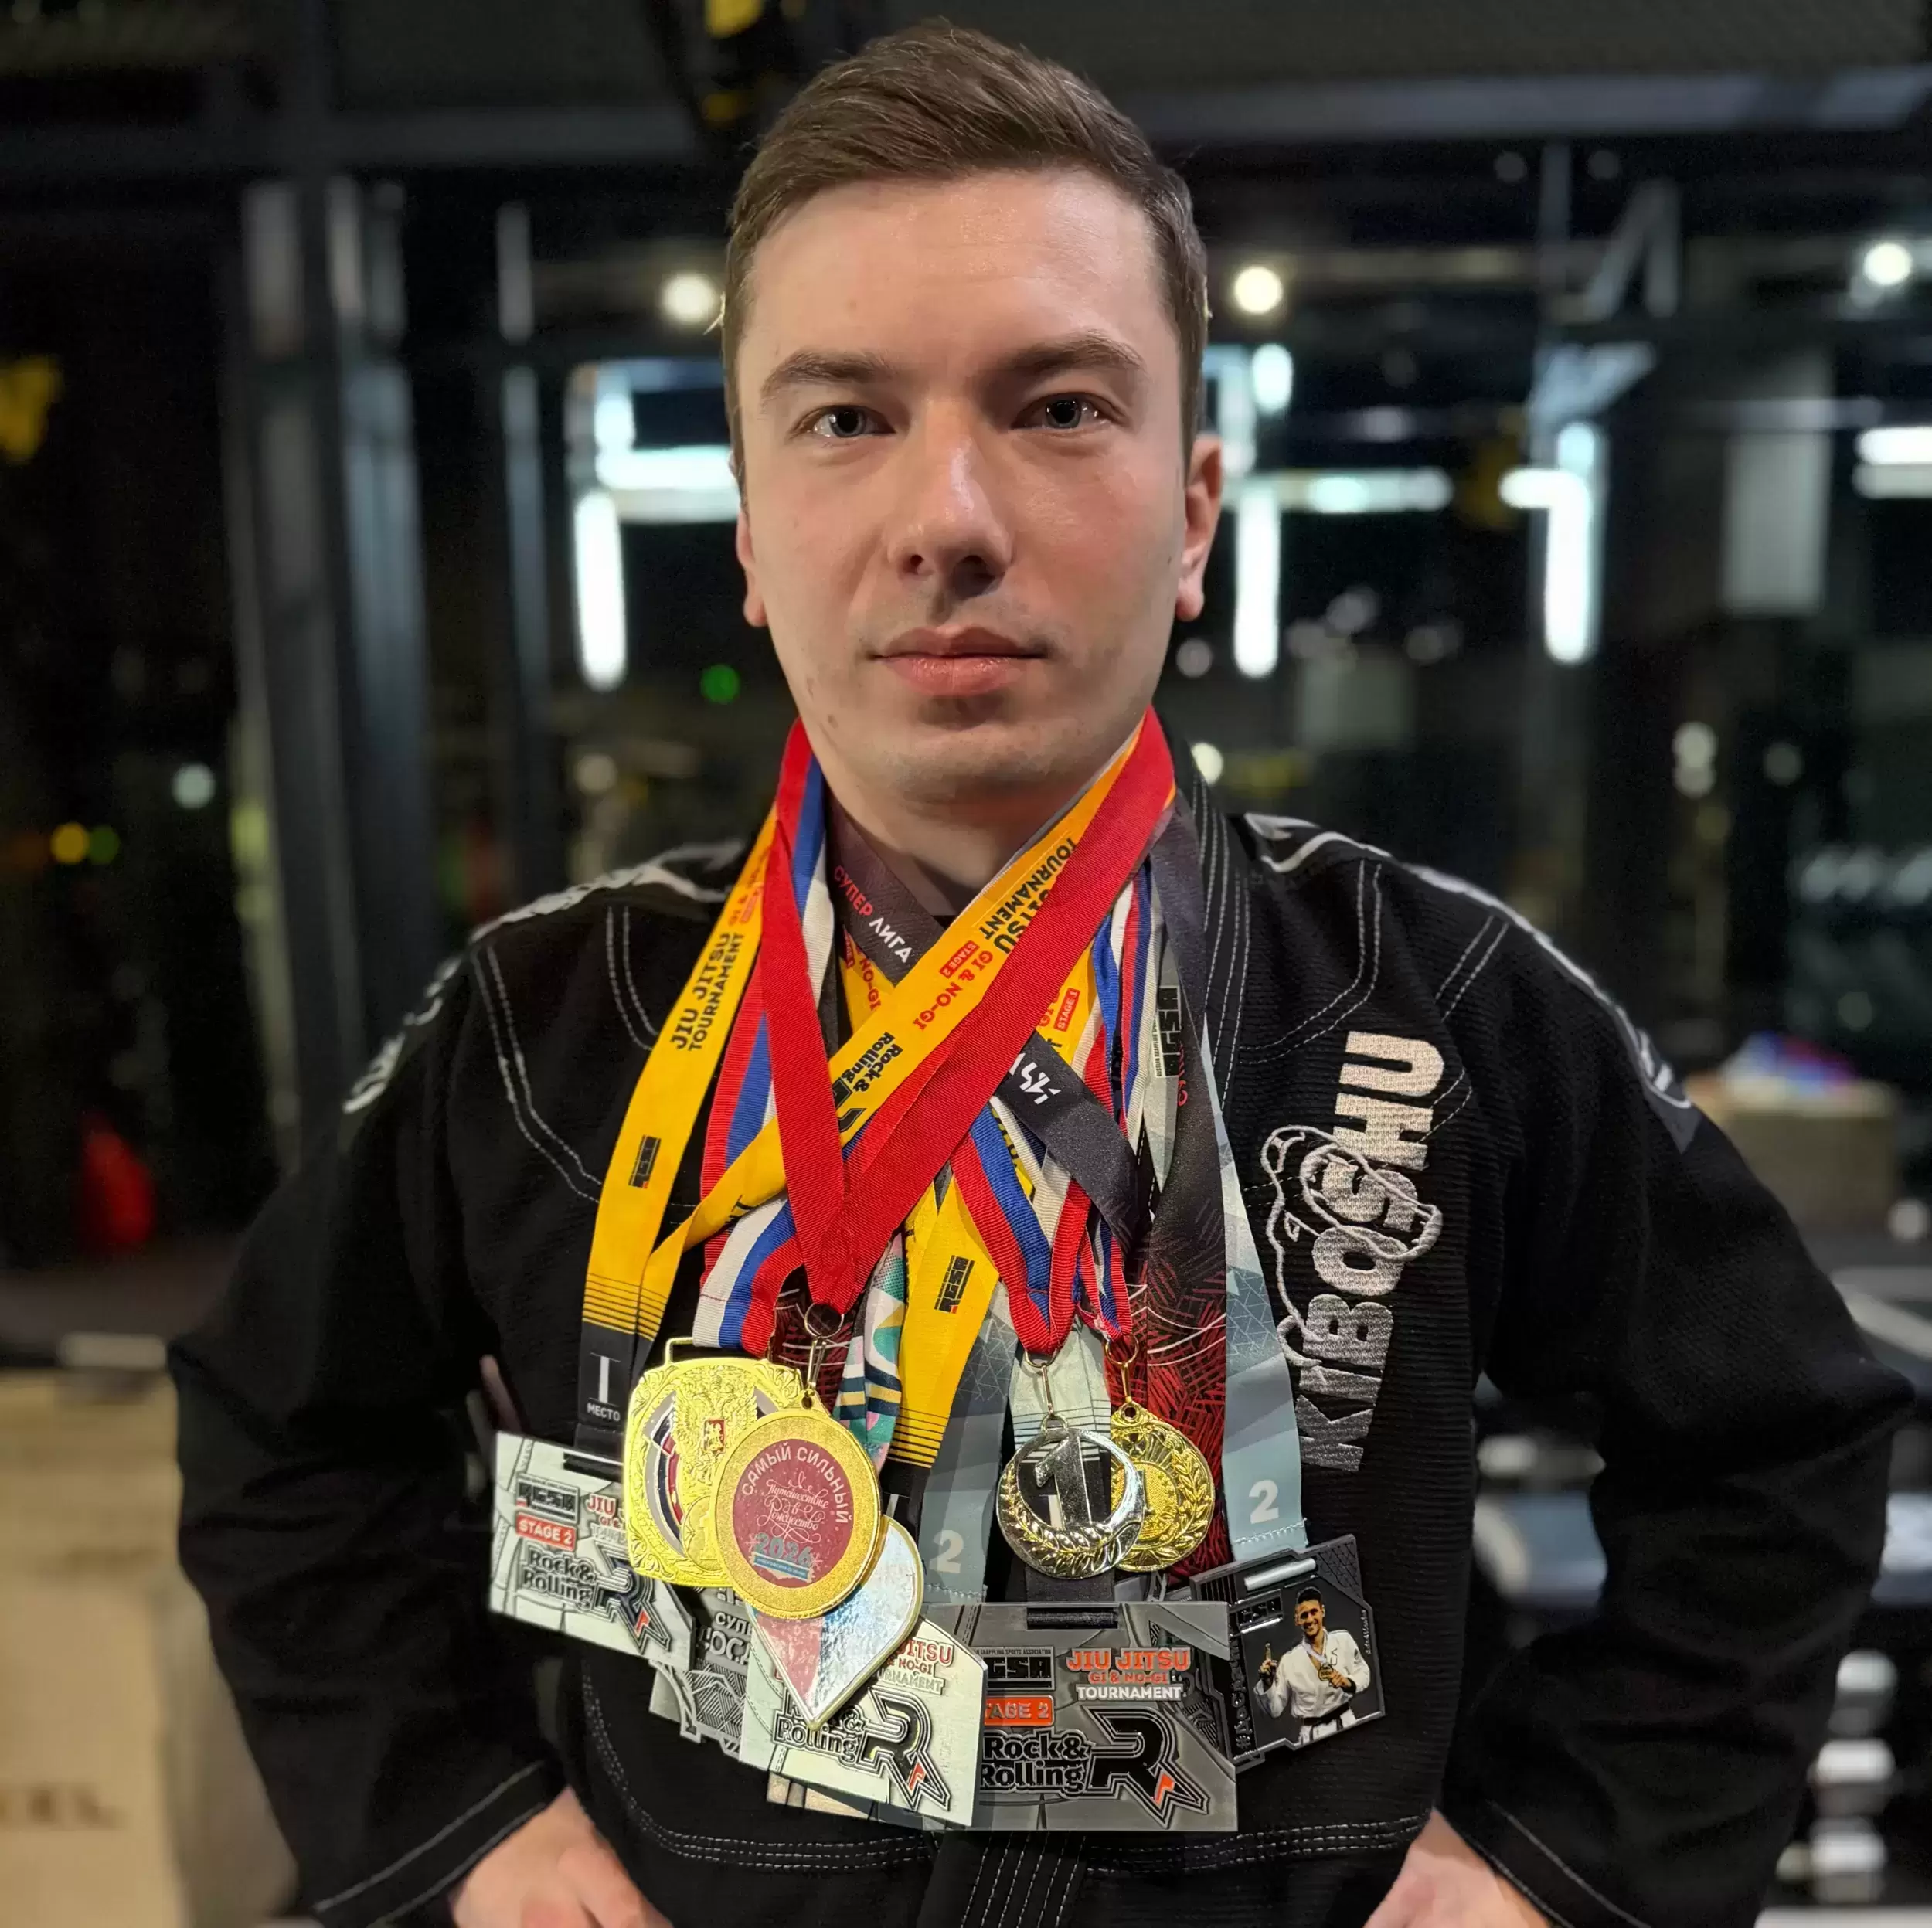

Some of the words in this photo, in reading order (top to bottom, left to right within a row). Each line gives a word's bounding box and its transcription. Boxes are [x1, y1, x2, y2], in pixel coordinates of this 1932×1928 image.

[979, 837, 1077, 940] TOURNAMENT
[834, 865, 873, 916] СУПЕР
[869, 917, 912, 963] ЛИГА
[948, 943, 976, 969] STAGE
[971, 950, 993, 971] GI
[670, 1008, 699, 1049] JIU
[692, 933, 730, 999] JITSU
[859, 958, 881, 1010] NO-GI
[958, 969, 975, 981] &
[688, 932, 745, 1051] TOURNAMENT
[913, 981, 962, 1029] NO-GI
[1057, 997, 1075, 1029] STAGE
[841, 1032, 896, 1083] Rolling
[853, 1044, 903, 1092] Rock&
[587, 1403, 621, 1421] МЕСТО
[742, 1441, 791, 1495] САМЫЙ
[797, 1447, 852, 1523] СИЛЬНЫЙ
[587, 1494, 616, 1515] JIU
[1249, 1479, 1279, 1524] 2
[519, 1518, 561, 1542] STAGE
[563, 1531, 573, 1546] 2
[530, 1549, 597, 1581] Rock&
[754, 1533, 812, 1567] 2026
[929, 1530, 964, 1573] 2
[523, 1569, 594, 1610] Rolling
[716, 1612, 752, 1636] СУП
[899, 1658, 934, 1675] NO-GI
[1067, 1649, 1111, 1671] JIU
[1115, 1648, 1190, 1671] JITSU
[877, 1669, 944, 1695] URNAMENT
[1077, 1686, 1182, 1700] TOURNAMENT
[1088, 1671, 1107, 1685] GI
[1110, 1671, 1120, 1685] &
[1124, 1671, 1168, 1685] NO-GI
[1038, 1702, 1049, 1719] 2
[777, 1716, 859, 1763] Rolling
[984, 1731, 1090, 1760] Rock&
[980, 1760, 1085, 1793] Rolling
